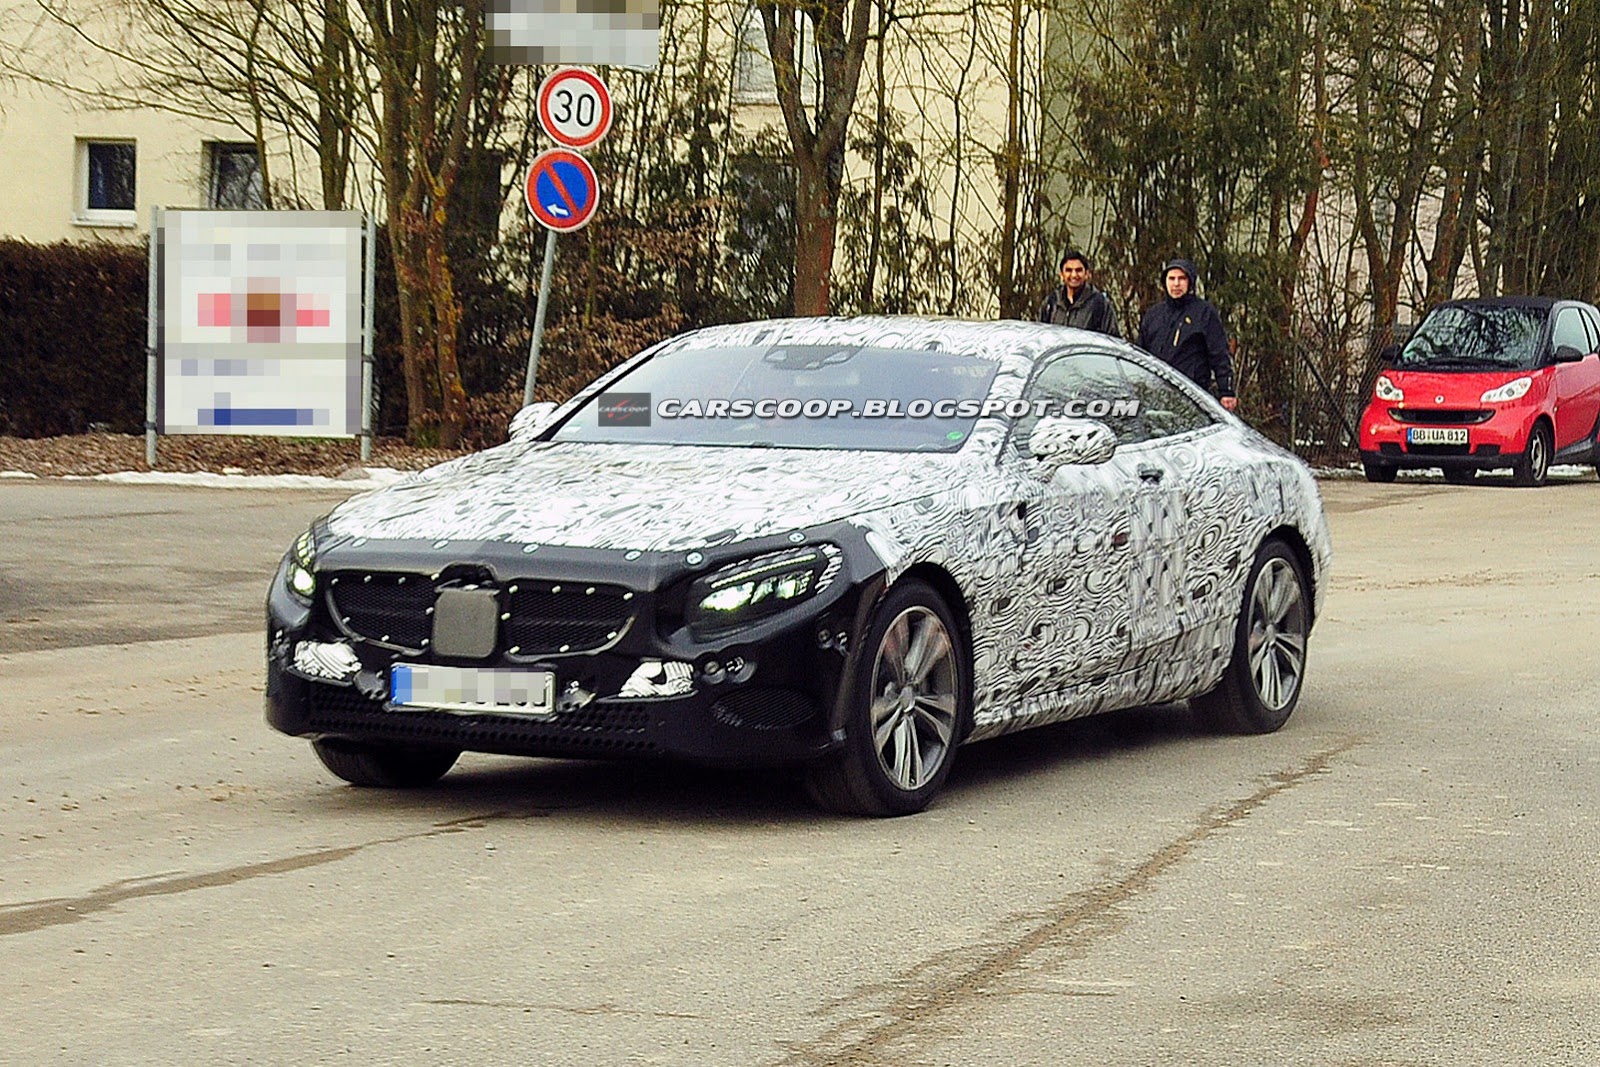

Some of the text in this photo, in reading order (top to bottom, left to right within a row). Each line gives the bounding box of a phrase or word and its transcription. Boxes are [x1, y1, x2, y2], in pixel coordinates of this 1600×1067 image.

[554, 90, 595, 127] 30
[1432, 430, 1446, 441] UA
[1447, 430, 1466, 441] 812
